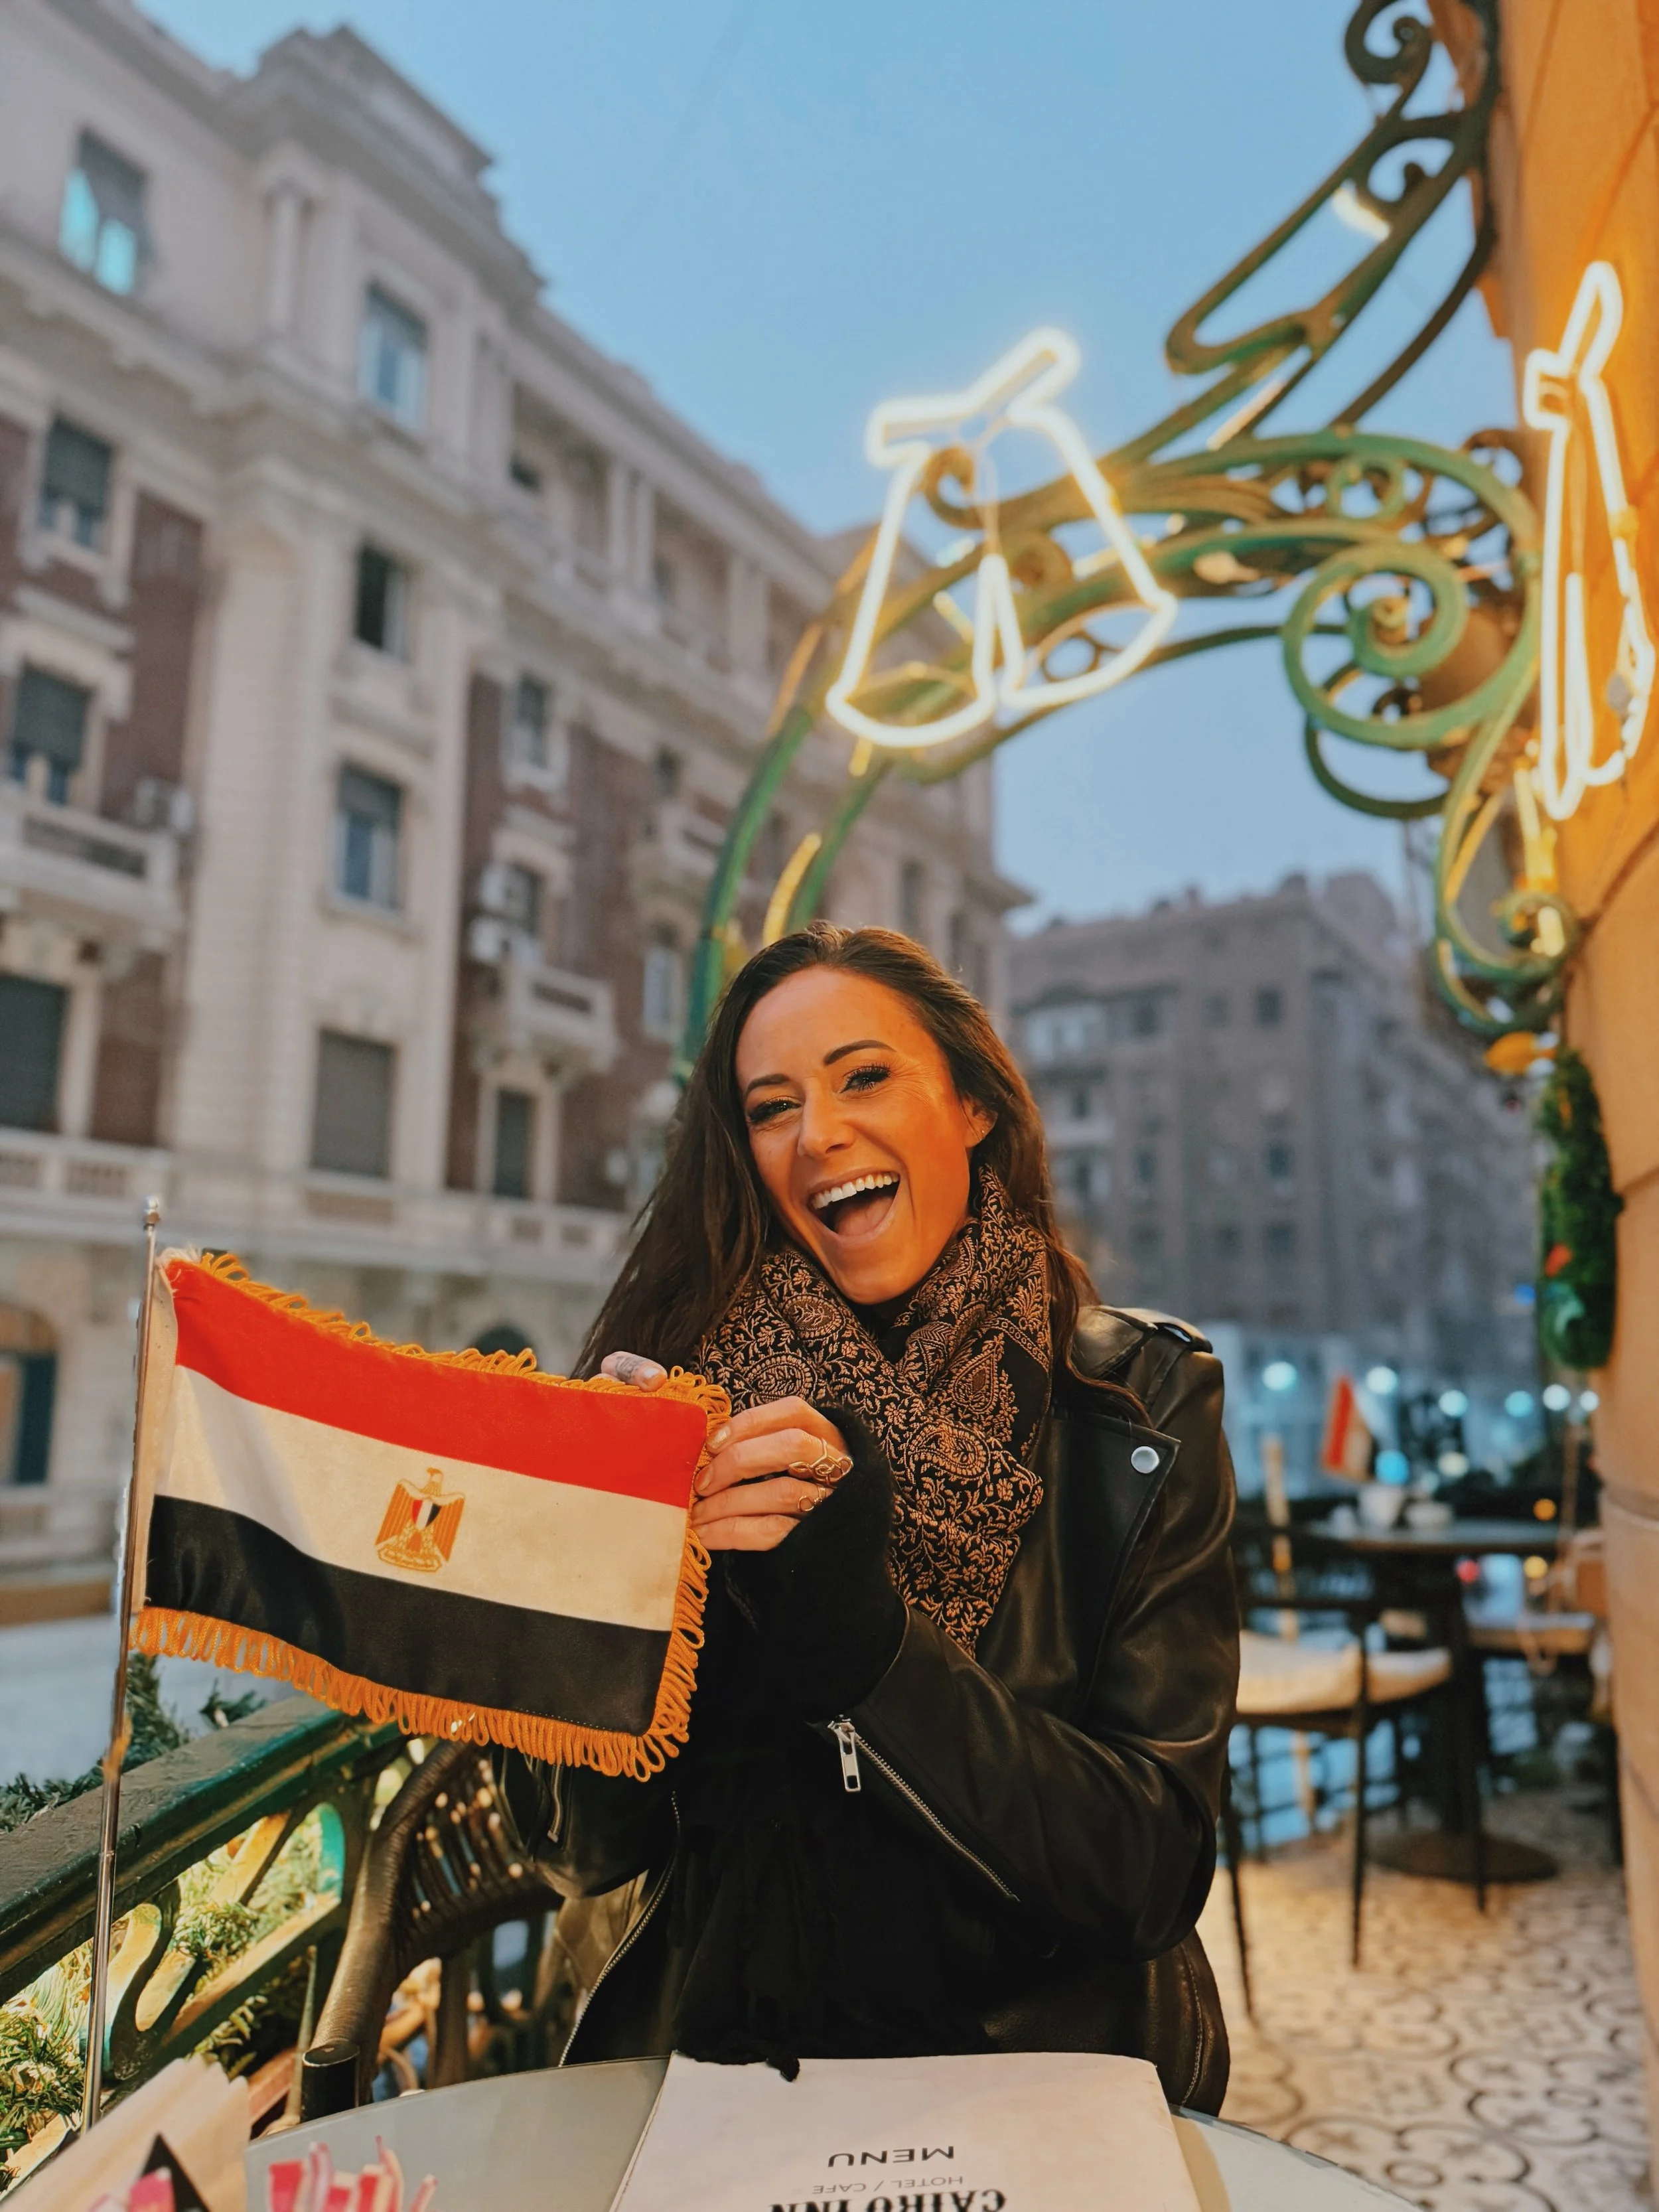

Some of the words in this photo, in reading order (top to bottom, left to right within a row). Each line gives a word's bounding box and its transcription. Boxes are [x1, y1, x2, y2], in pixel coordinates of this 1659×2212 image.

[828, 2146, 954, 2167] MENU
[812, 2182, 867, 2195] CAFE
[891, 2176, 964, 2189] HOTEL
[865, 2189, 1007, 2212] CAIRO
